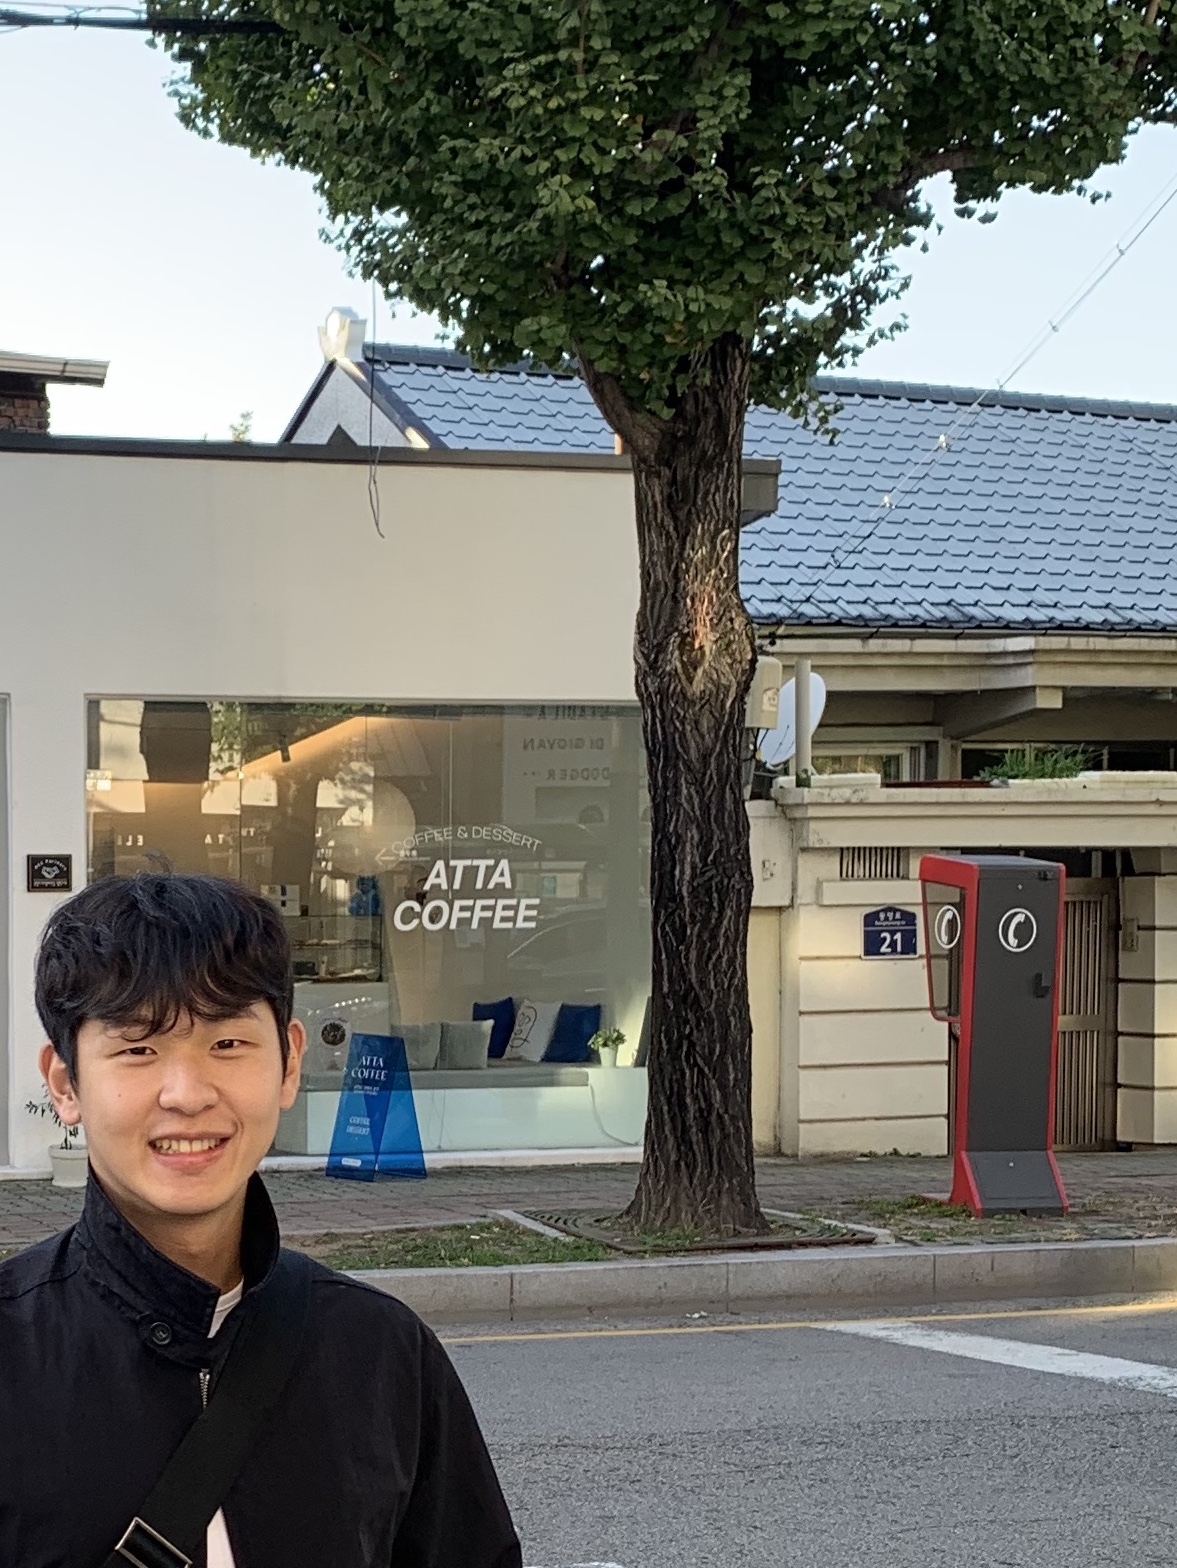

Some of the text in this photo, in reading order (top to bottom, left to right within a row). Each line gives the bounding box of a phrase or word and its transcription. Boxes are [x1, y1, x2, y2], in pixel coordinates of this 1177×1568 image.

[391, 825, 543, 853] COFFEE & DESSERT
[423, 858, 512, 891] ATTA
[393, 898, 541, 932] COFFEE
[879, 932, 902, 953] 21
[358, 1055, 384, 1067] ATTA
[351, 1067, 389, 1080] COFFEE
